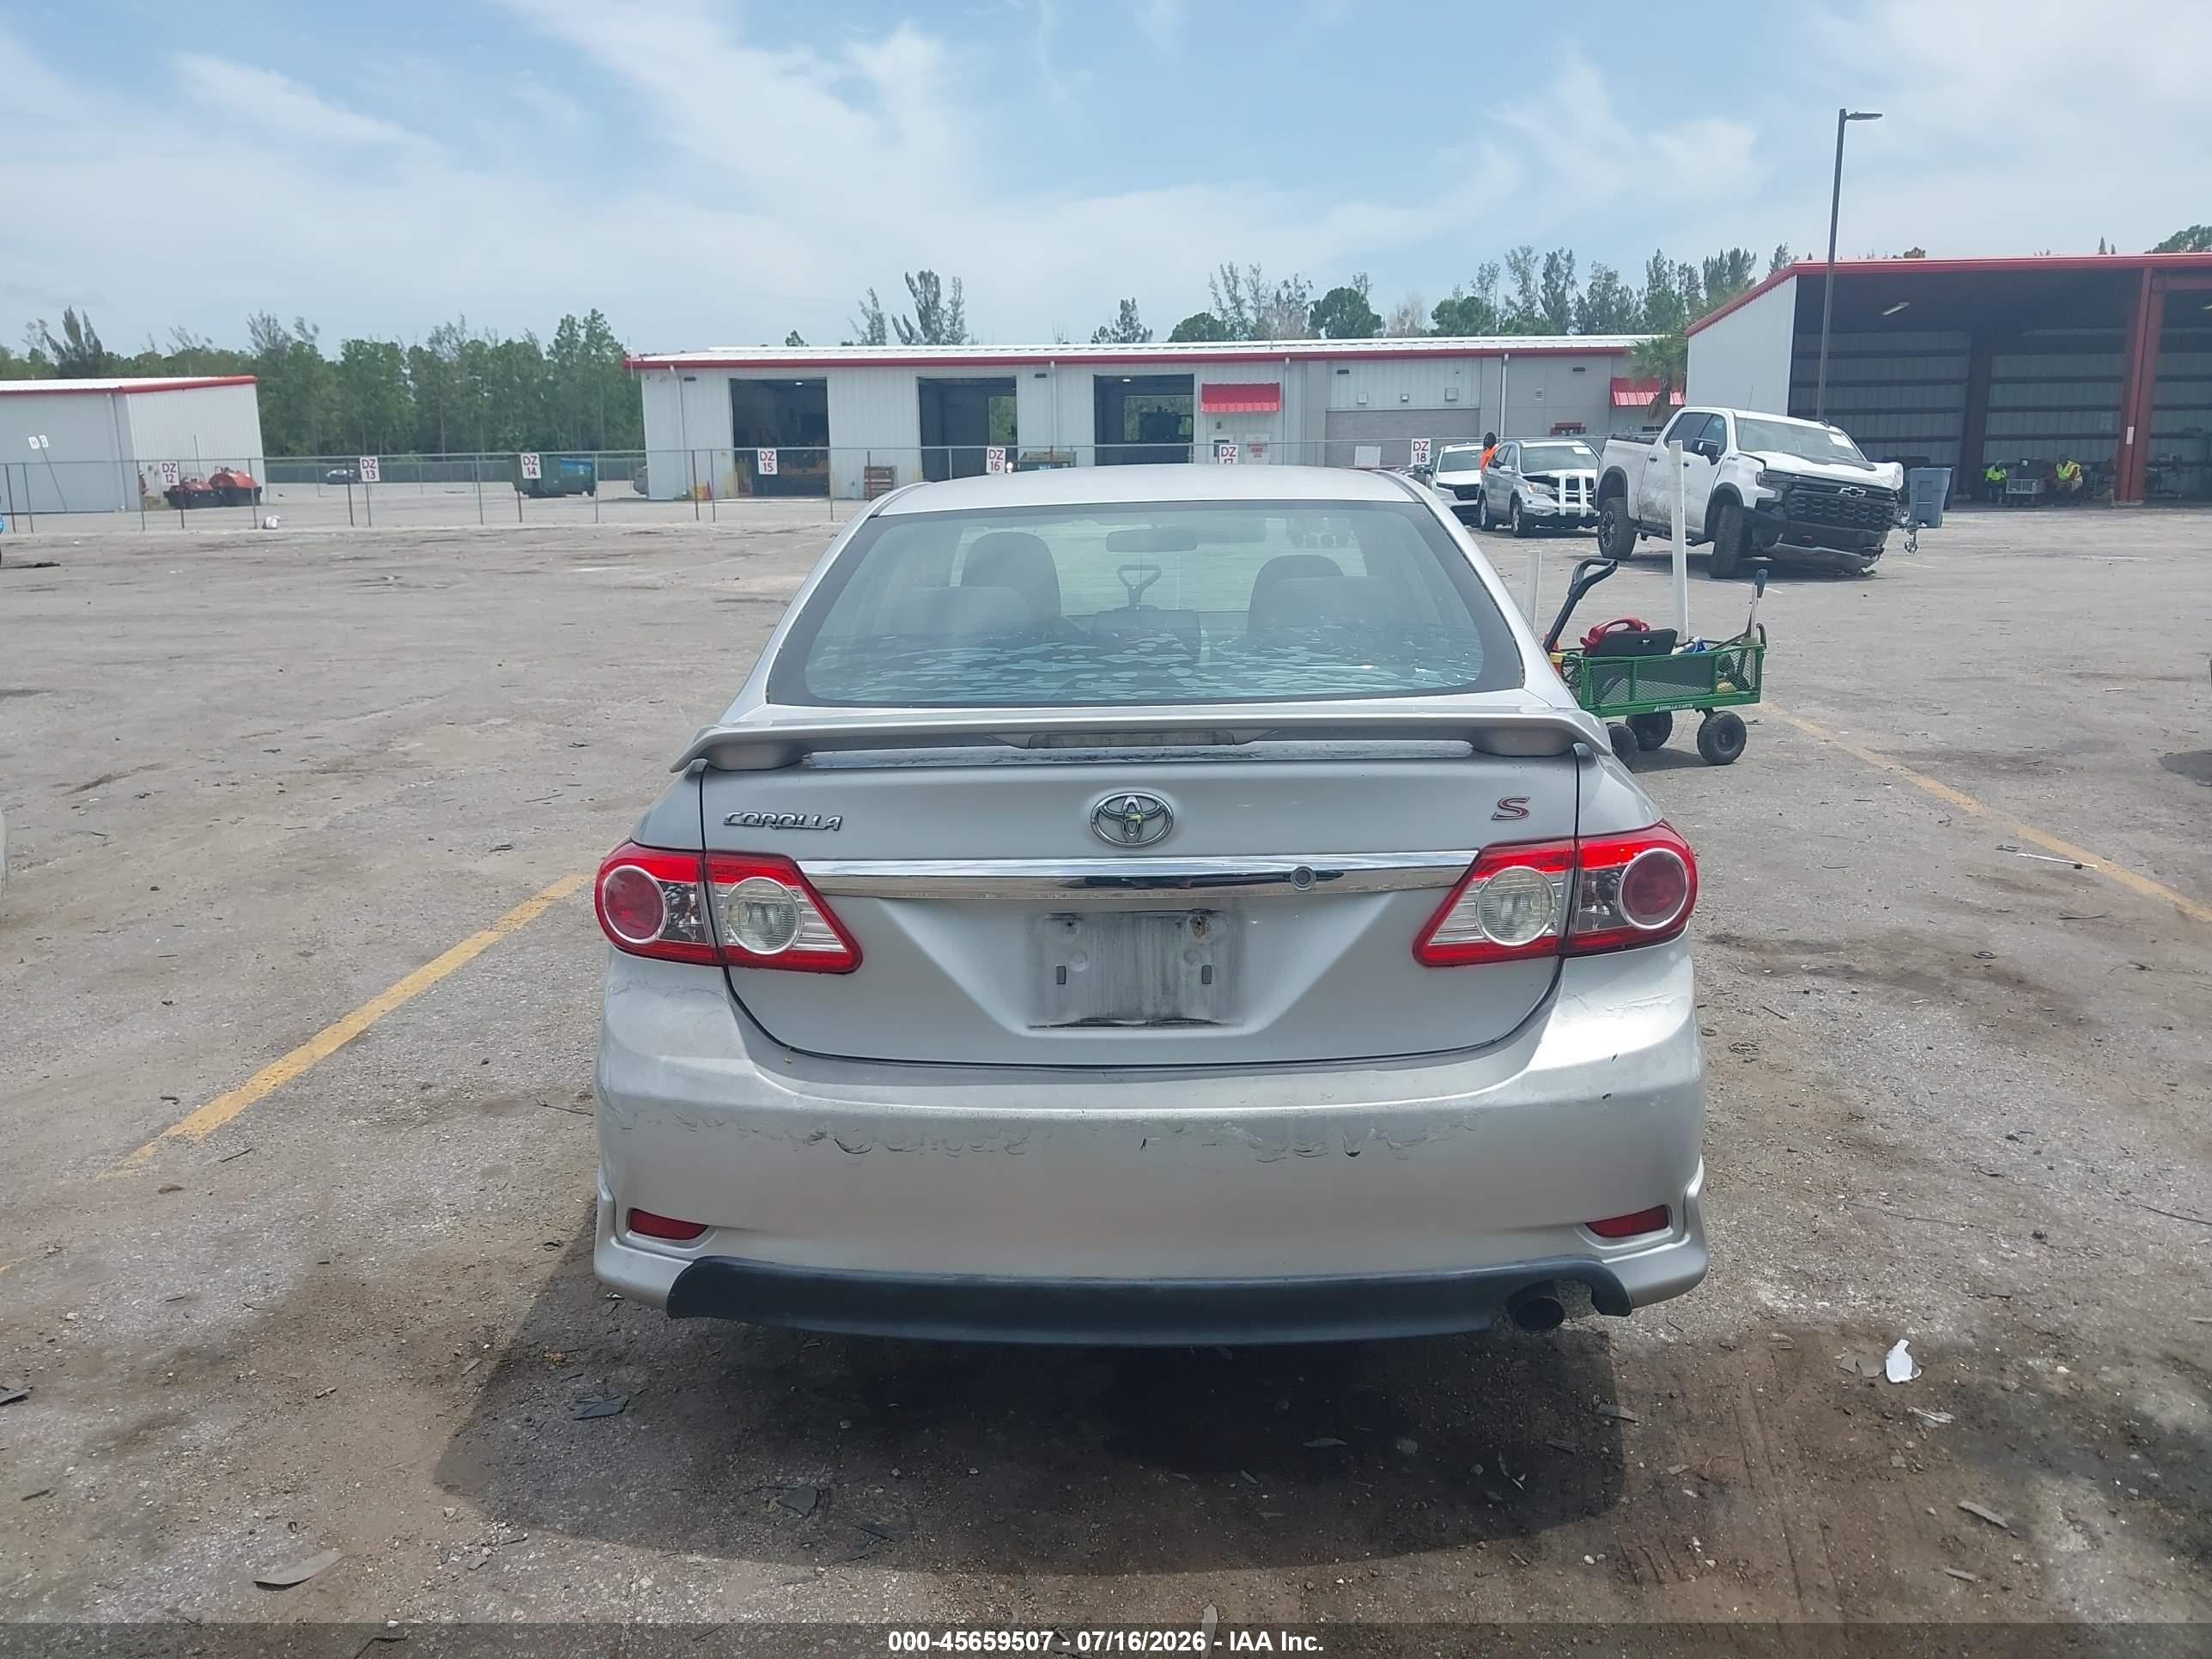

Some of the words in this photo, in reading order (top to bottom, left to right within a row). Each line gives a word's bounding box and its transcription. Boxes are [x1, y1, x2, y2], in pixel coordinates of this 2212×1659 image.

[1413, 441, 1429, 451] DZ
[760, 451, 775, 460] DZ
[989, 449, 1003, 460] DZ
[1221, 447, 1237, 457] DZ
[523, 456, 538, 465] DZ
[1417, 453, 1426, 462] 18
[162, 463, 176, 472] DZ
[362, 459, 376, 469] DZ
[763, 463, 773, 471] 15
[991, 461, 1000, 471] 16
[366, 470, 375, 479] 13
[527, 467, 537, 477] 14
[166, 474, 174, 483] 12
[1491, 796, 1531, 821] S
[723, 811, 842, 831] COROLLA
